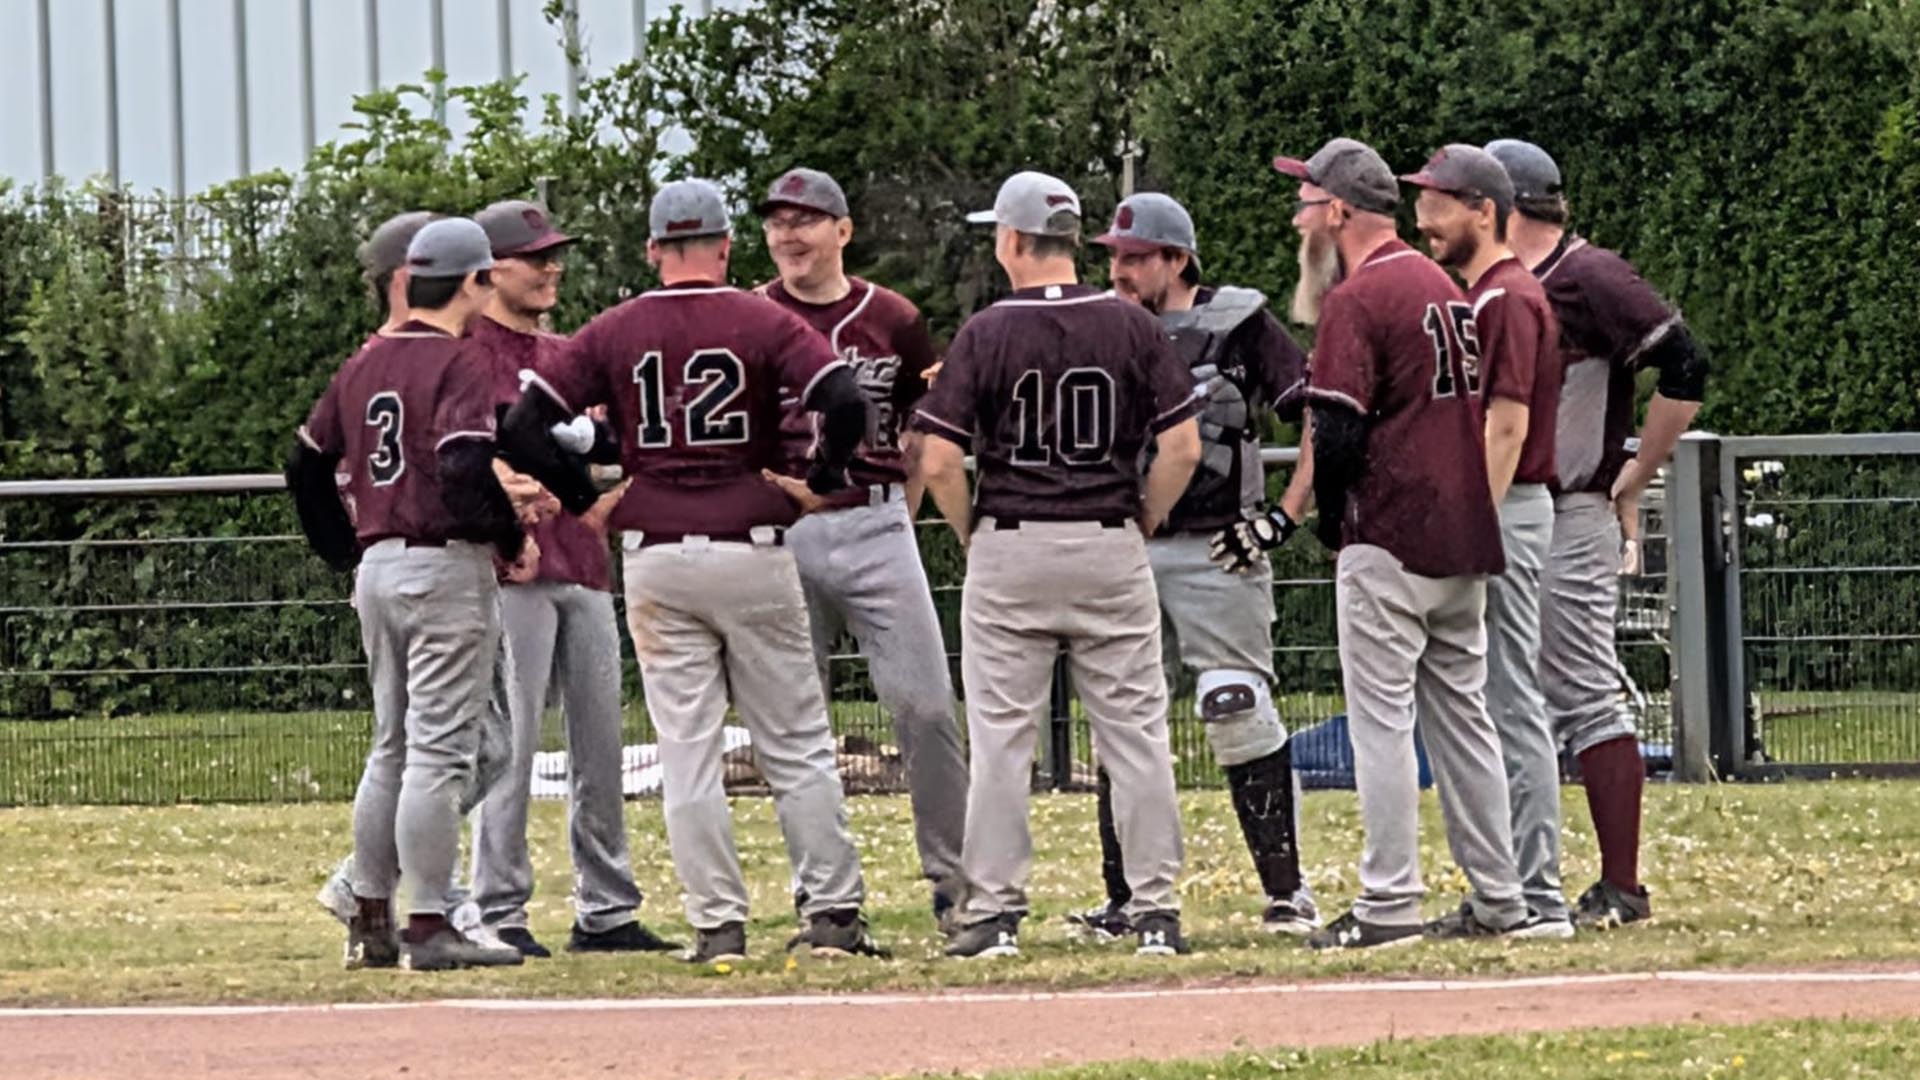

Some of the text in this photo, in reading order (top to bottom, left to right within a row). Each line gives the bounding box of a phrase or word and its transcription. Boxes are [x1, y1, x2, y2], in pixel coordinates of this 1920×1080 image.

[632, 348, 749, 448] 12
[1422, 300, 1482, 400] 15
[365, 390, 406, 487] 3
[1010, 366, 1116, 466] 10
